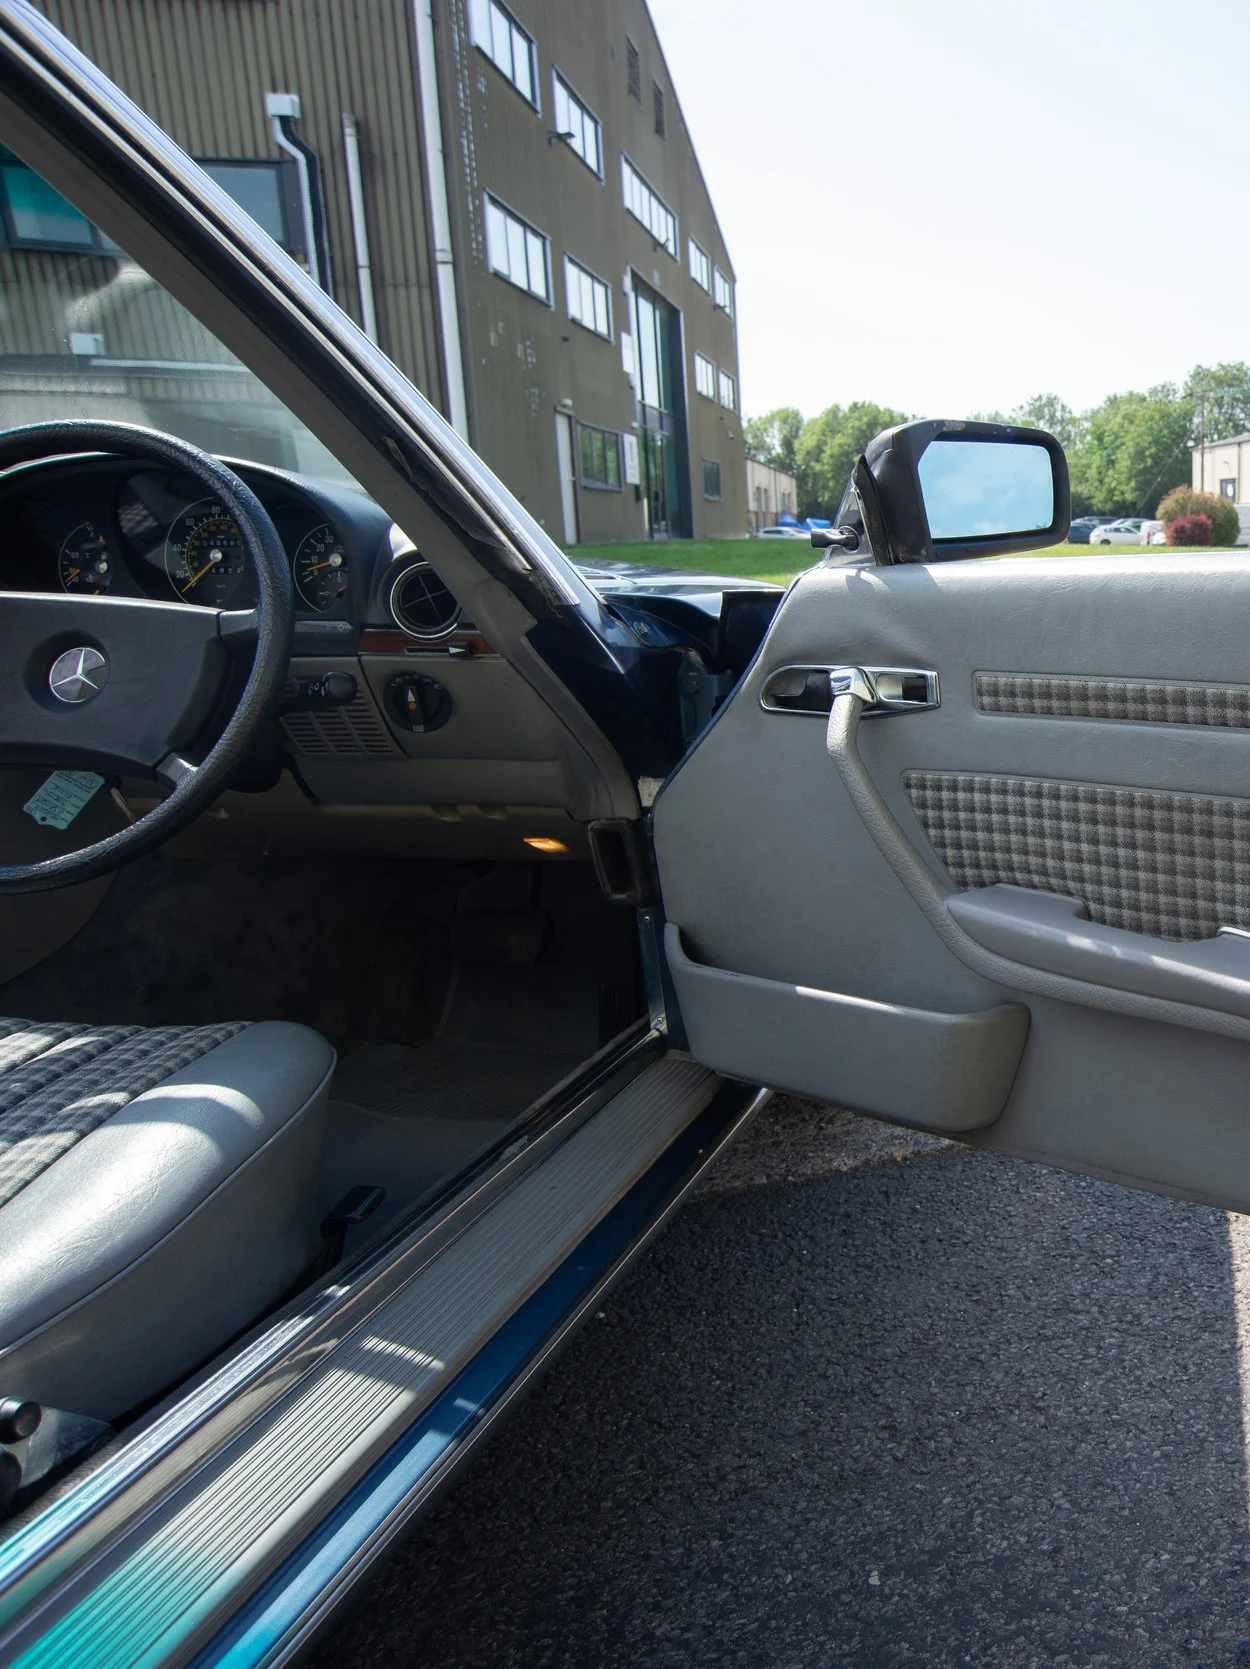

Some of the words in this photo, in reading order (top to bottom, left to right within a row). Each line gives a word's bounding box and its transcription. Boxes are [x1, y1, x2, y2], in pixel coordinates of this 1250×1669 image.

[325, 535, 334, 544] 30
[172, 544, 182, 552] 40
[316, 543, 325, 552] 20
[311, 555, 319, 564] 10
[175, 570, 185, 579] 20
